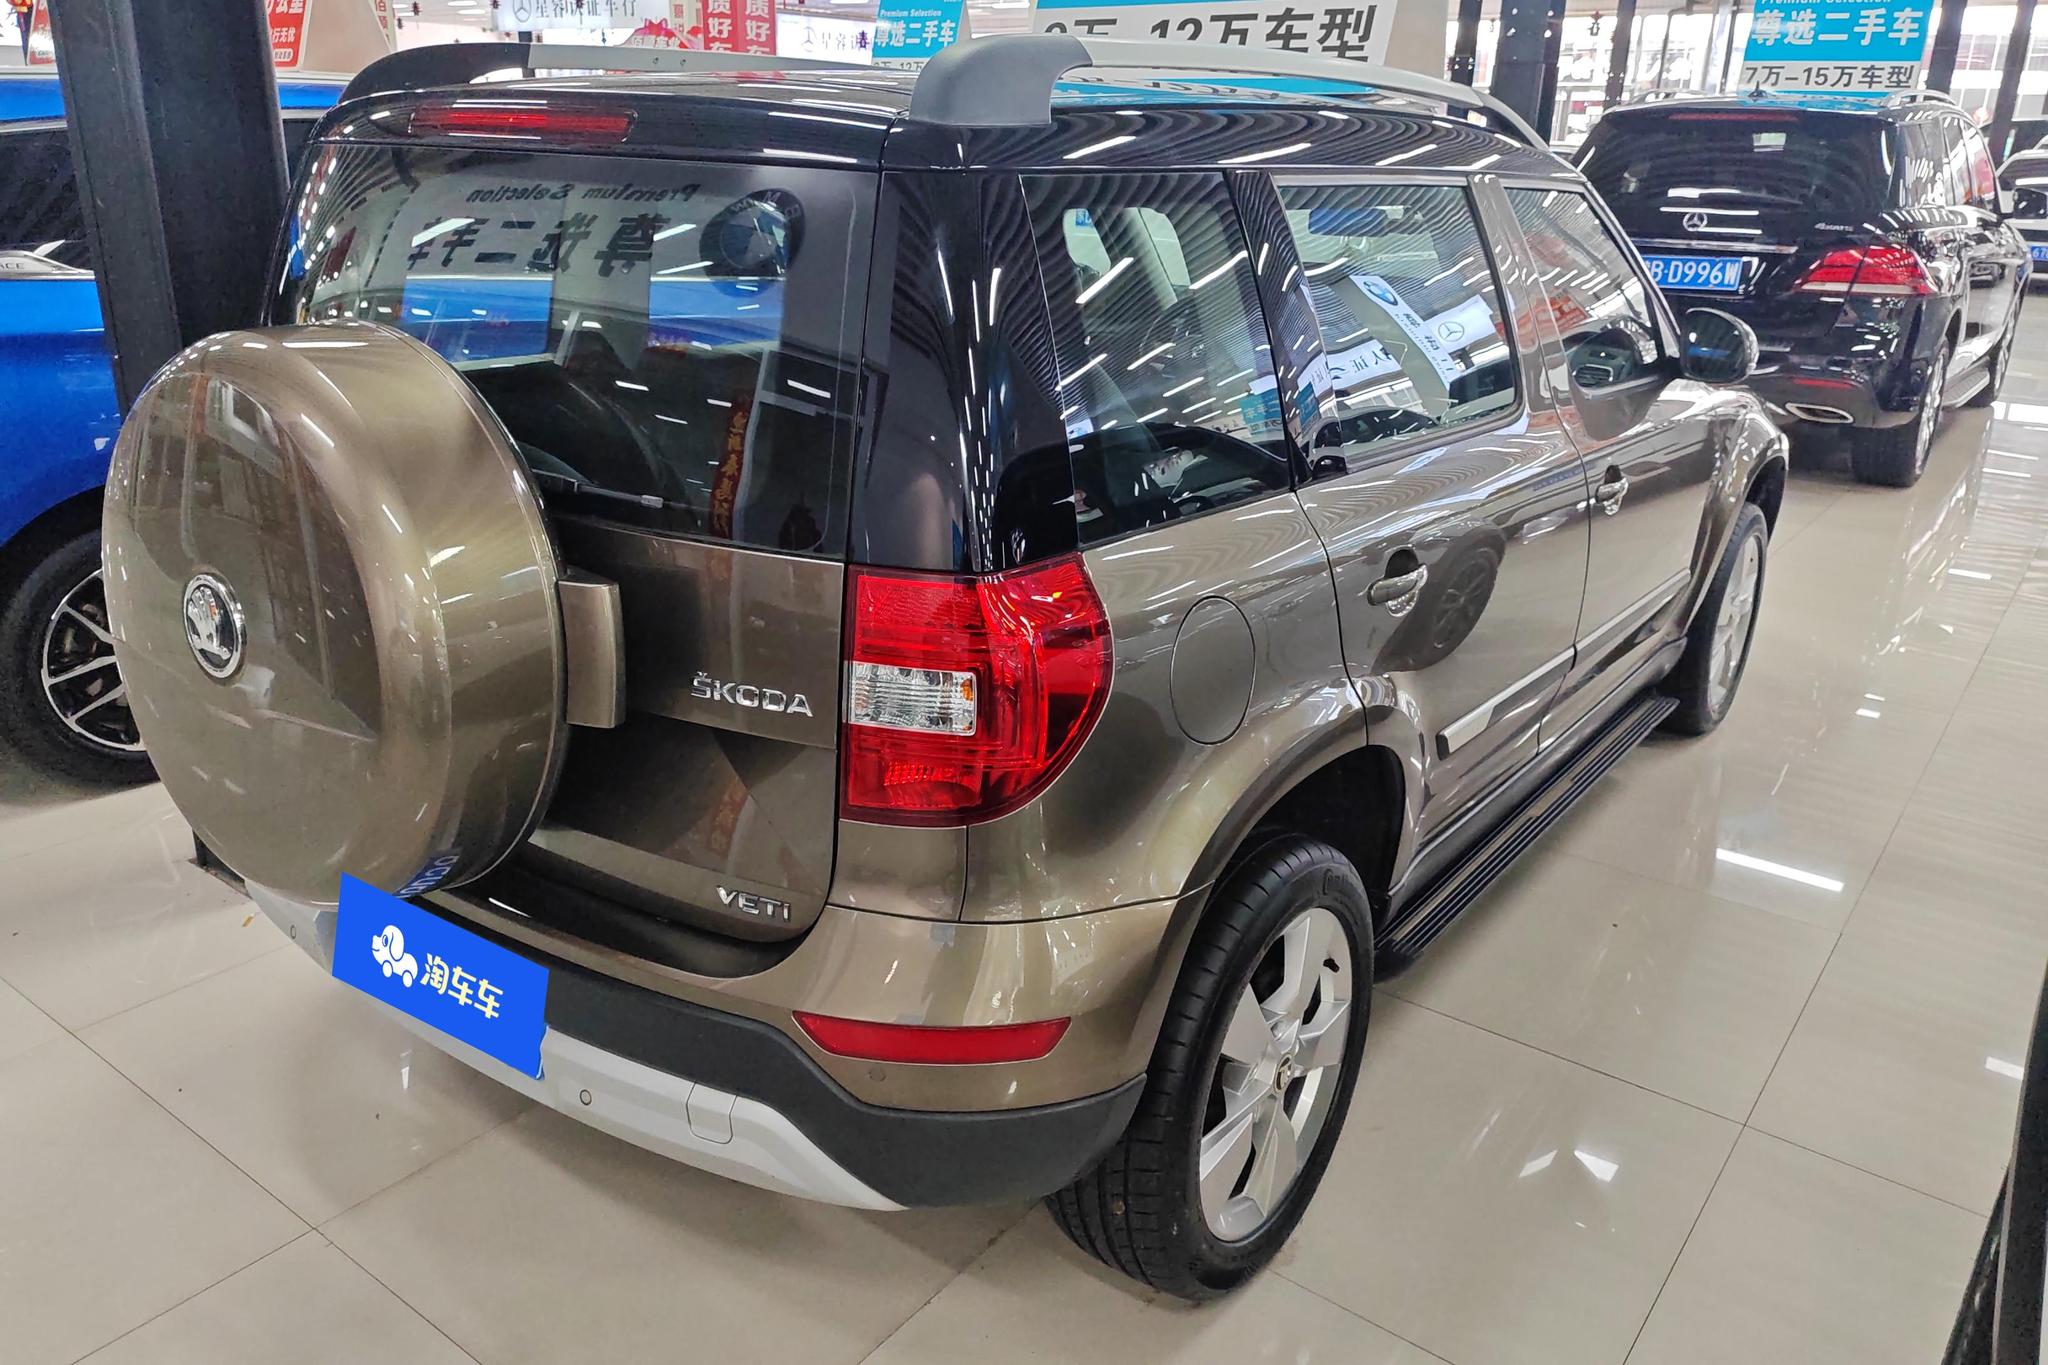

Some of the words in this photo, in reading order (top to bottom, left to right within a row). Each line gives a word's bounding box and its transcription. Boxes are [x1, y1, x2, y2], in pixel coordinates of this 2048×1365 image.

[880, 9, 908, 17] Premium
[910, 8, 942, 17] Selection
[876, 19, 956, 47] 尊选二手车
[1752, 7, 1924, 46] 尊选二手车
[1744, 65, 1914, 89] 7万-15万车型
[1645, 260, 1740, 286] B·D996W
[691, 671, 813, 718] ŠKODA
